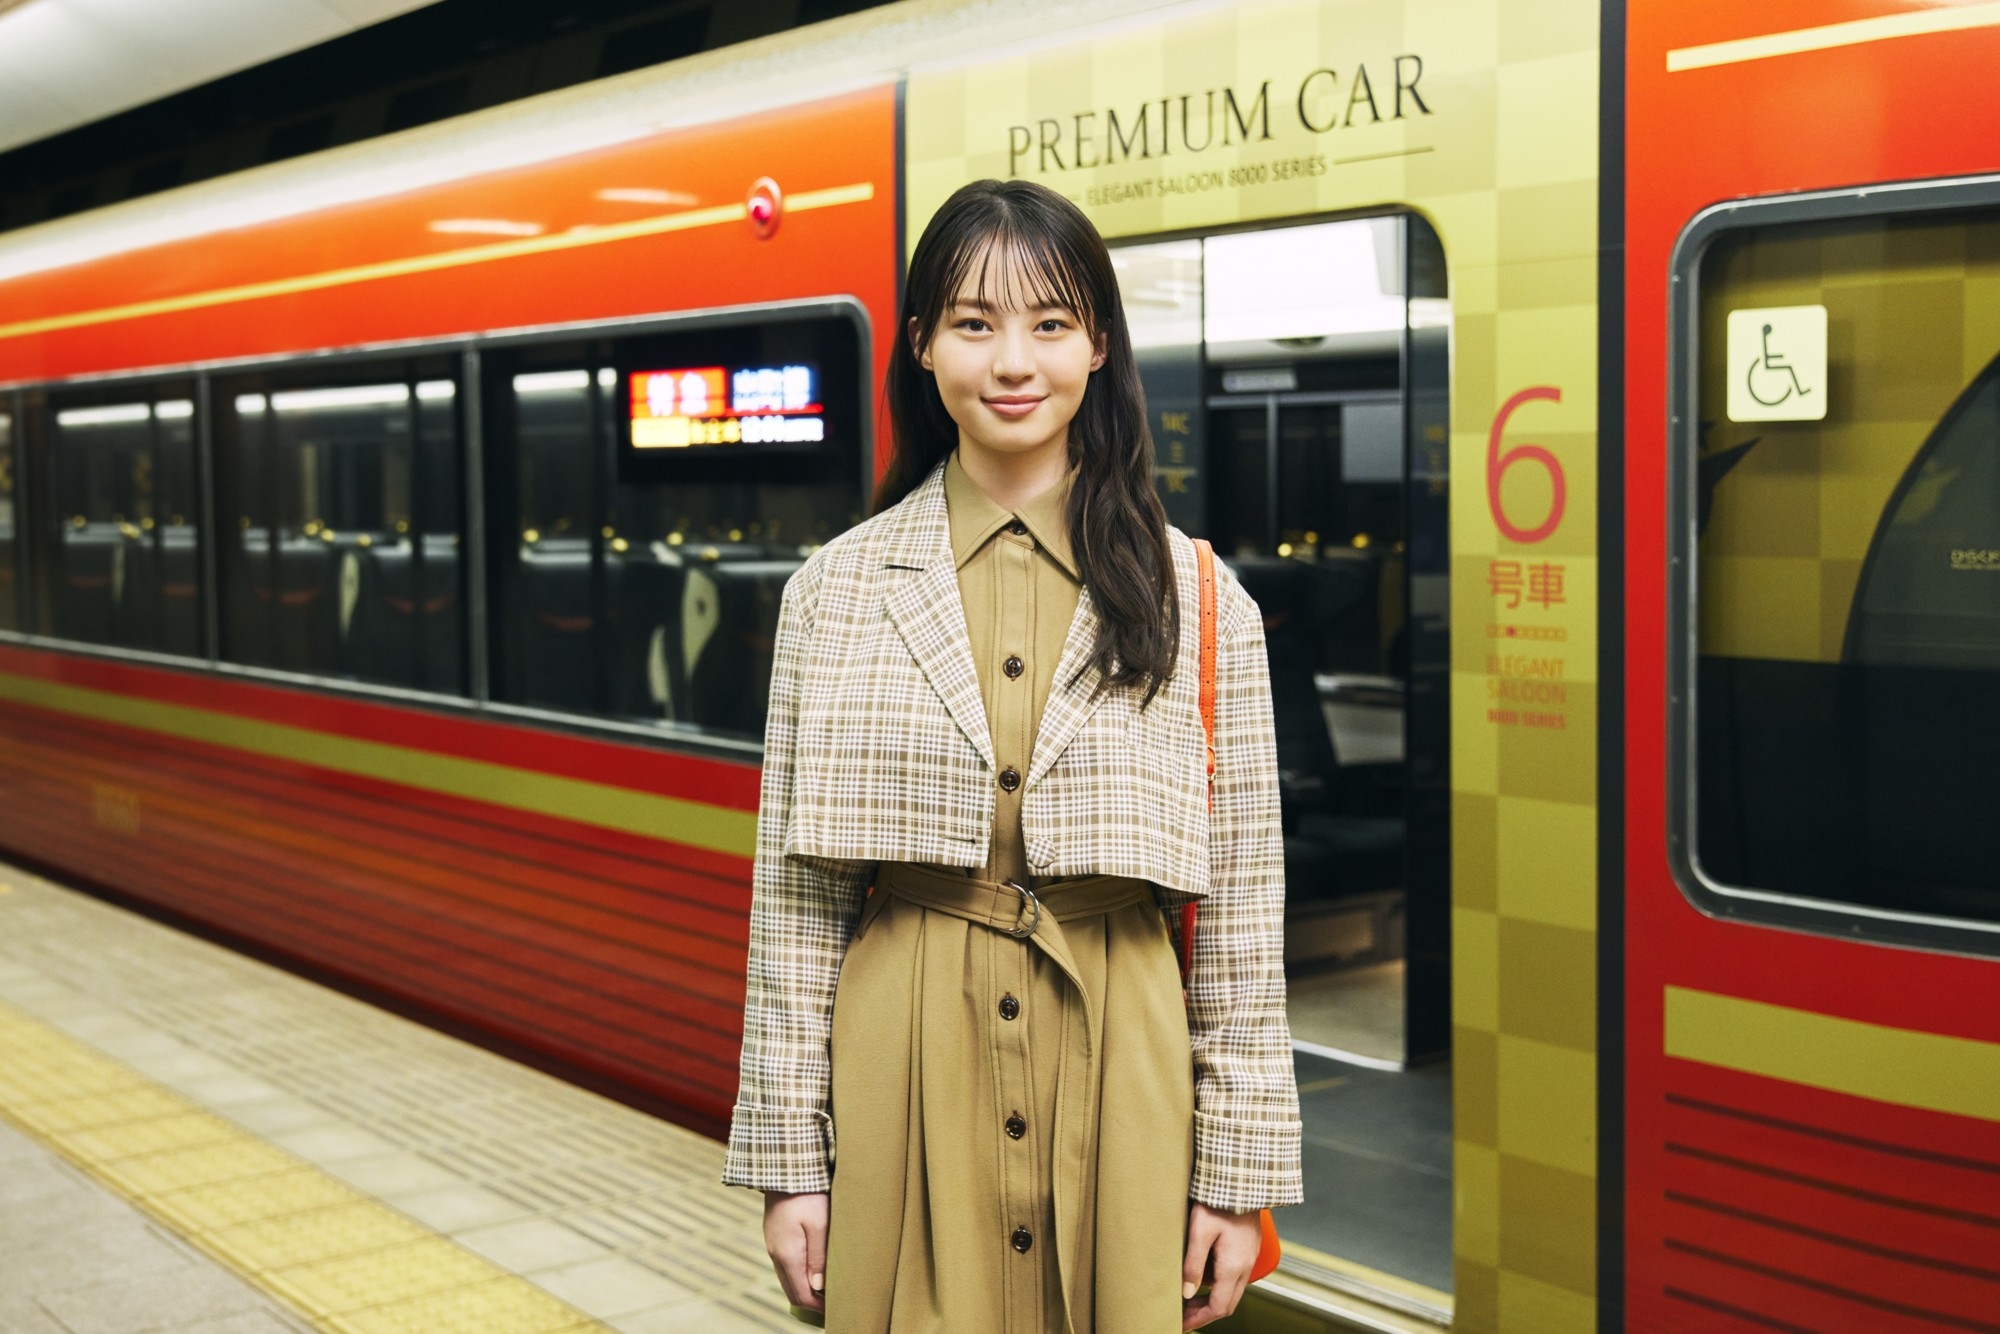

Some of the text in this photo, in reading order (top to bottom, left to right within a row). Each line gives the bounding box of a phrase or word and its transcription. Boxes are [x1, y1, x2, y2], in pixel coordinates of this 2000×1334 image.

[1008, 54, 1434, 177] PREMIUM CAR
[1086, 180, 1152, 206] ELEGANT
[1156, 172, 1224, 197] SALOON
[1271, 155, 1328, 182] SERIES
[1486, 385, 1567, 544] 6
[1488, 561, 1567, 609] 号車
[1486, 654, 1565, 680] ELEGANT
[1487, 678, 1567, 704] SALOON
